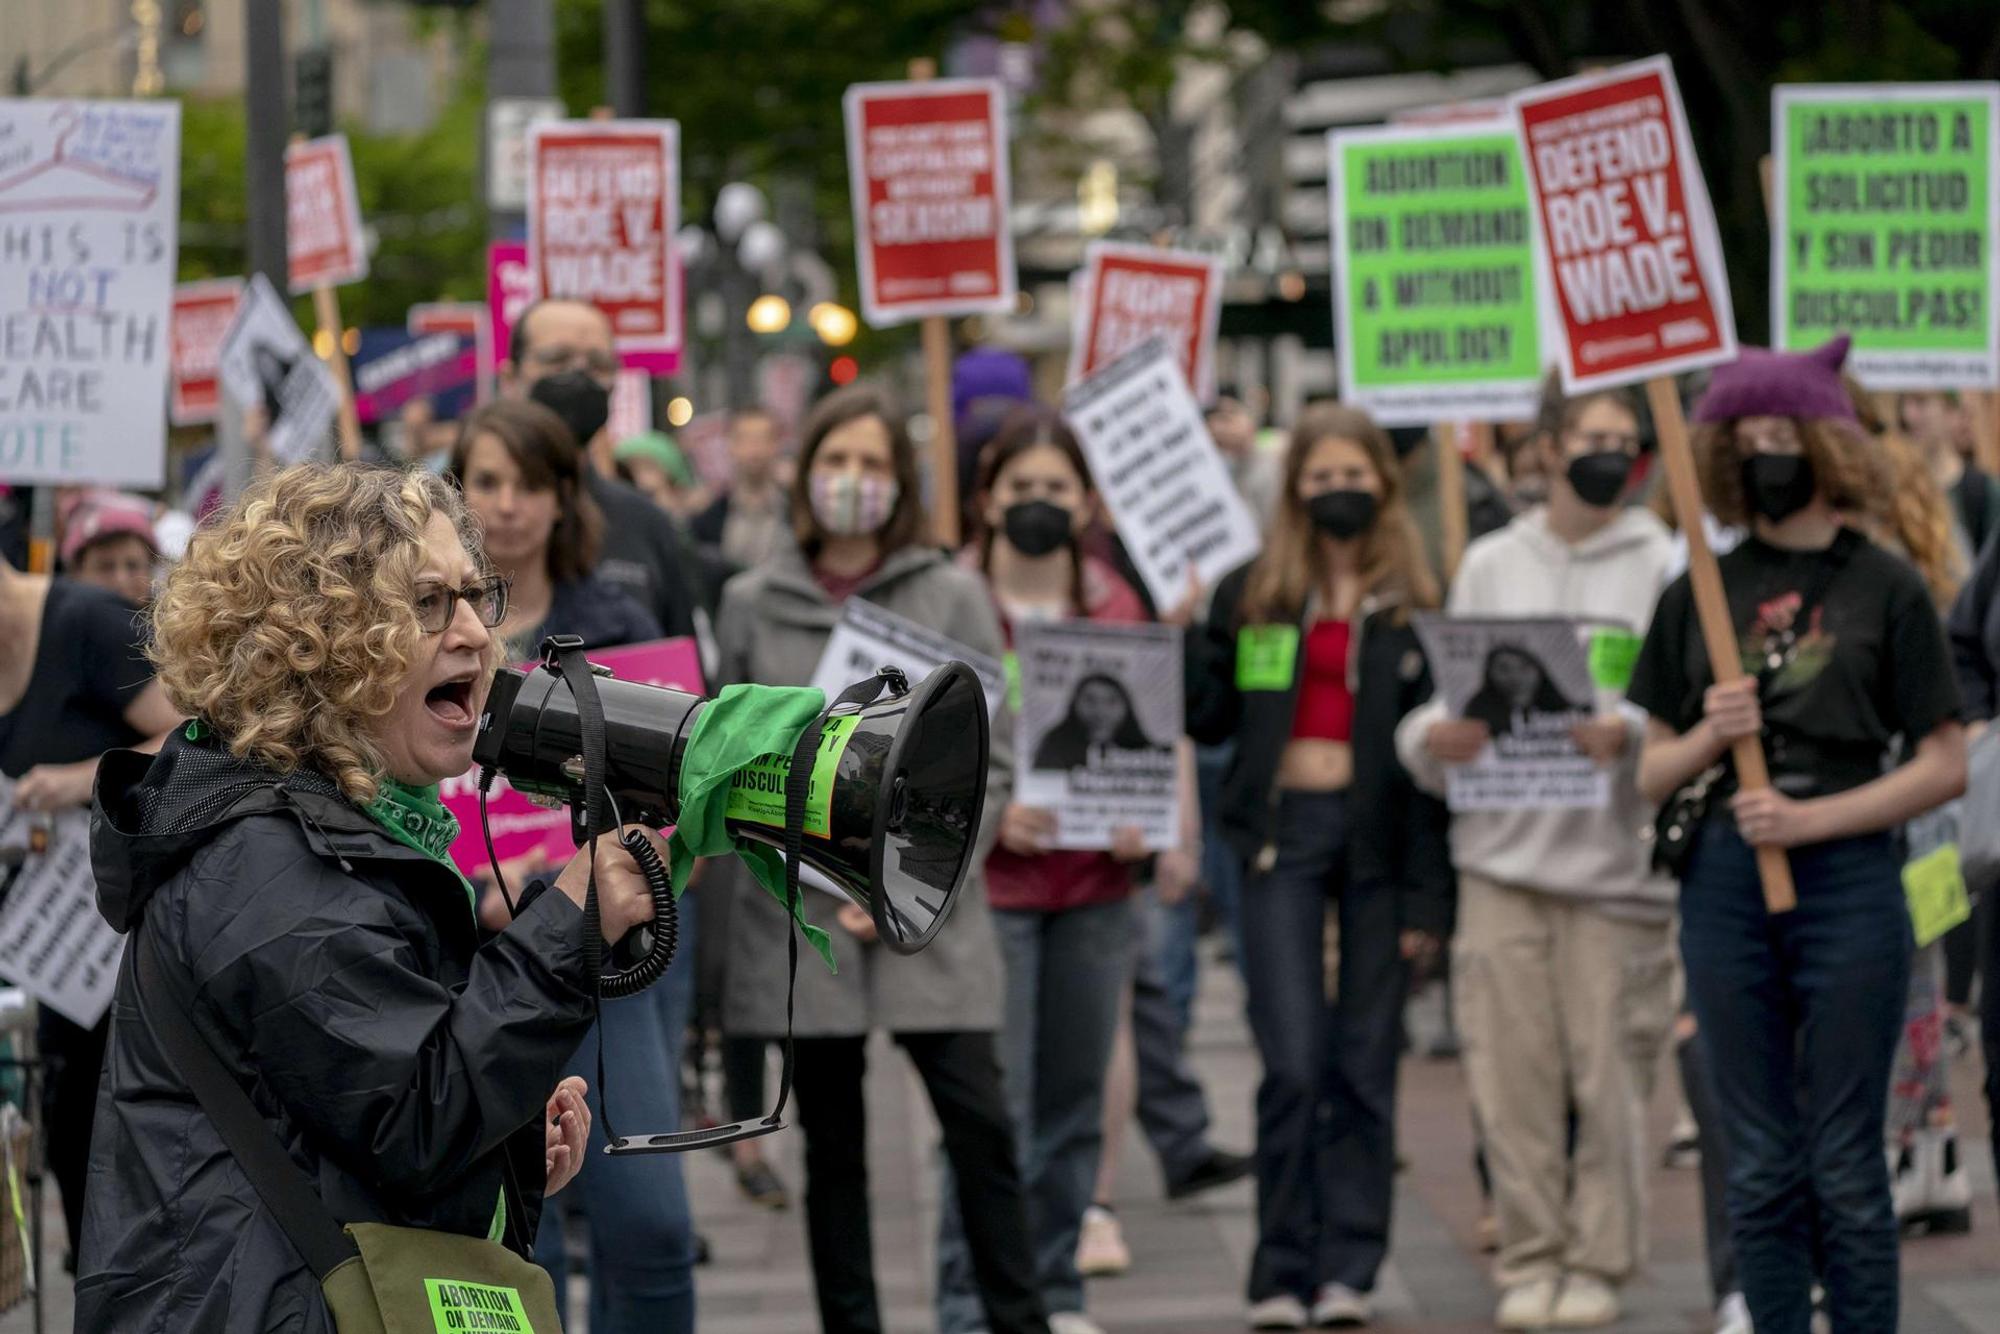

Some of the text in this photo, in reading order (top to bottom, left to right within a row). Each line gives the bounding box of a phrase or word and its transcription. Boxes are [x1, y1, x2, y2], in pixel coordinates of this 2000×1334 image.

[1952, 110, 1972, 152] A
[1365, 149, 1509, 194] ABORTION
[1537, 117, 1671, 194] DEFEND
[1806, 170, 1968, 214] SOLICITUD
[1352, 207, 1529, 253] ON DEMAND
[1549, 172, 1684, 257] ROE V.
[4, 219, 165, 265] HIS IS
[1794, 229, 1981, 272] Y SIN PEDIR
[28, 268, 118, 310] NOT
[1393, 265, 1522, 308] WITHOUT
[1560, 236, 1699, 325] WADE
[1795, 286, 1981, 331] DISCULPAS!
[5, 312, 157, 366] EALTH
[1379, 324, 1512, 368] APOLOGY
[0, 421, 86, 470] OTE
[732, 769, 815, 801] DISCUL!
[438, 1284, 514, 1313] ABORTION
[445, 1310, 521, 1331] ON DEMAND
